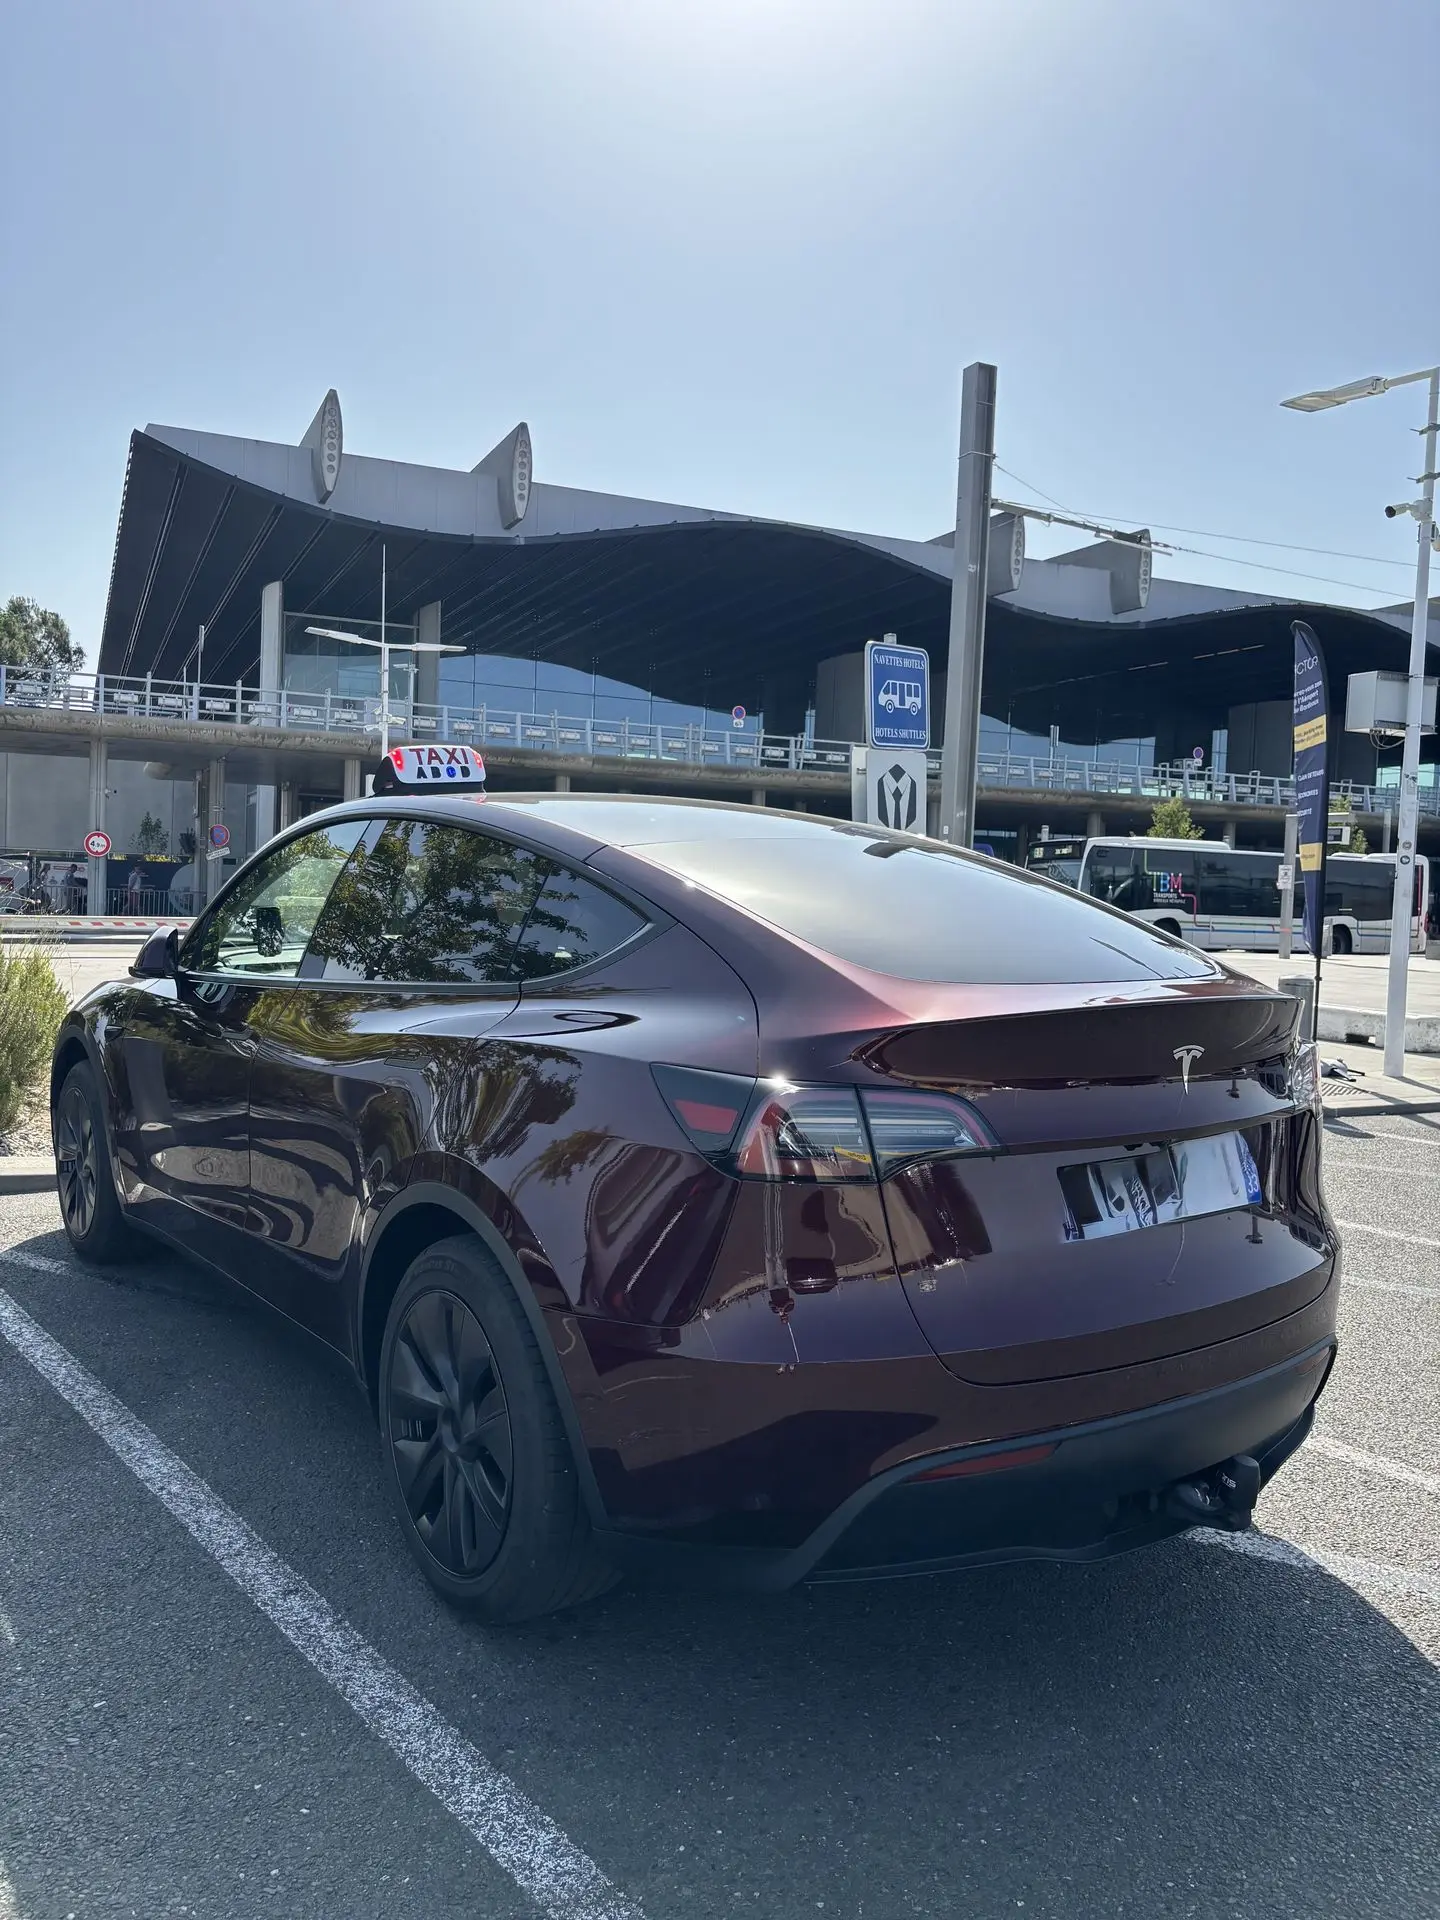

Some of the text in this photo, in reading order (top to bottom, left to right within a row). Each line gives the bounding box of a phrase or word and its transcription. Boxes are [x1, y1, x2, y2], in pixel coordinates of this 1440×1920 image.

[874, 654, 925, 670] NAVETTES HOTELS
[875, 727, 926, 740] HOTELS SHUTTLES
[408, 747, 469, 765] TAXI
[1149, 872, 1182, 892] TBM
[1247, 1174, 1259, 1193] 33
